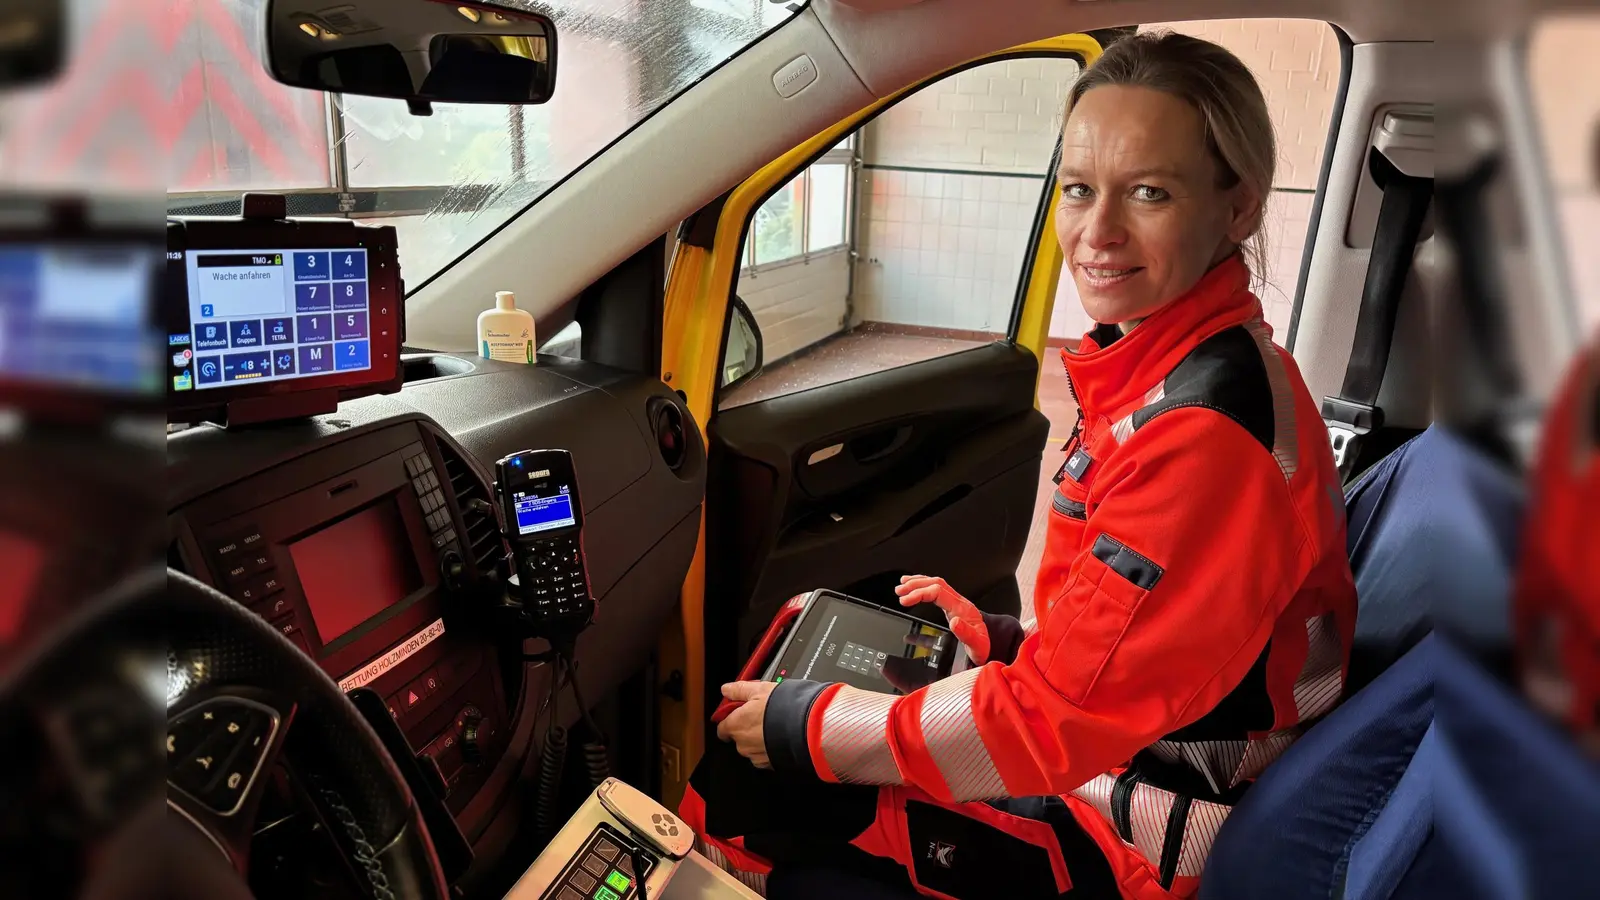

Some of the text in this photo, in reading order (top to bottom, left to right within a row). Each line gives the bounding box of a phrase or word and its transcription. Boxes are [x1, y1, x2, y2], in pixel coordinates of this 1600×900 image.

[252, 256, 267, 265] TMO
[307, 255, 316, 268] 3
[344, 254, 353, 267] 4
[212, 270, 271, 281] Wache anfahren
[308, 286, 317, 299] 7
[346, 284, 354, 297] 8
[310, 317, 318, 330] 1
[347, 314, 355, 327] 5
[197, 338, 227, 348] Telefonbuch
[236, 337, 257, 345] Gruppen
[310, 347, 322, 360] M
[348, 344, 356, 356] 2
[219, 543, 237, 554] RADIO
[341, 622, 443, 692] RETTUNG HOLZMINDEN 20-82-01
